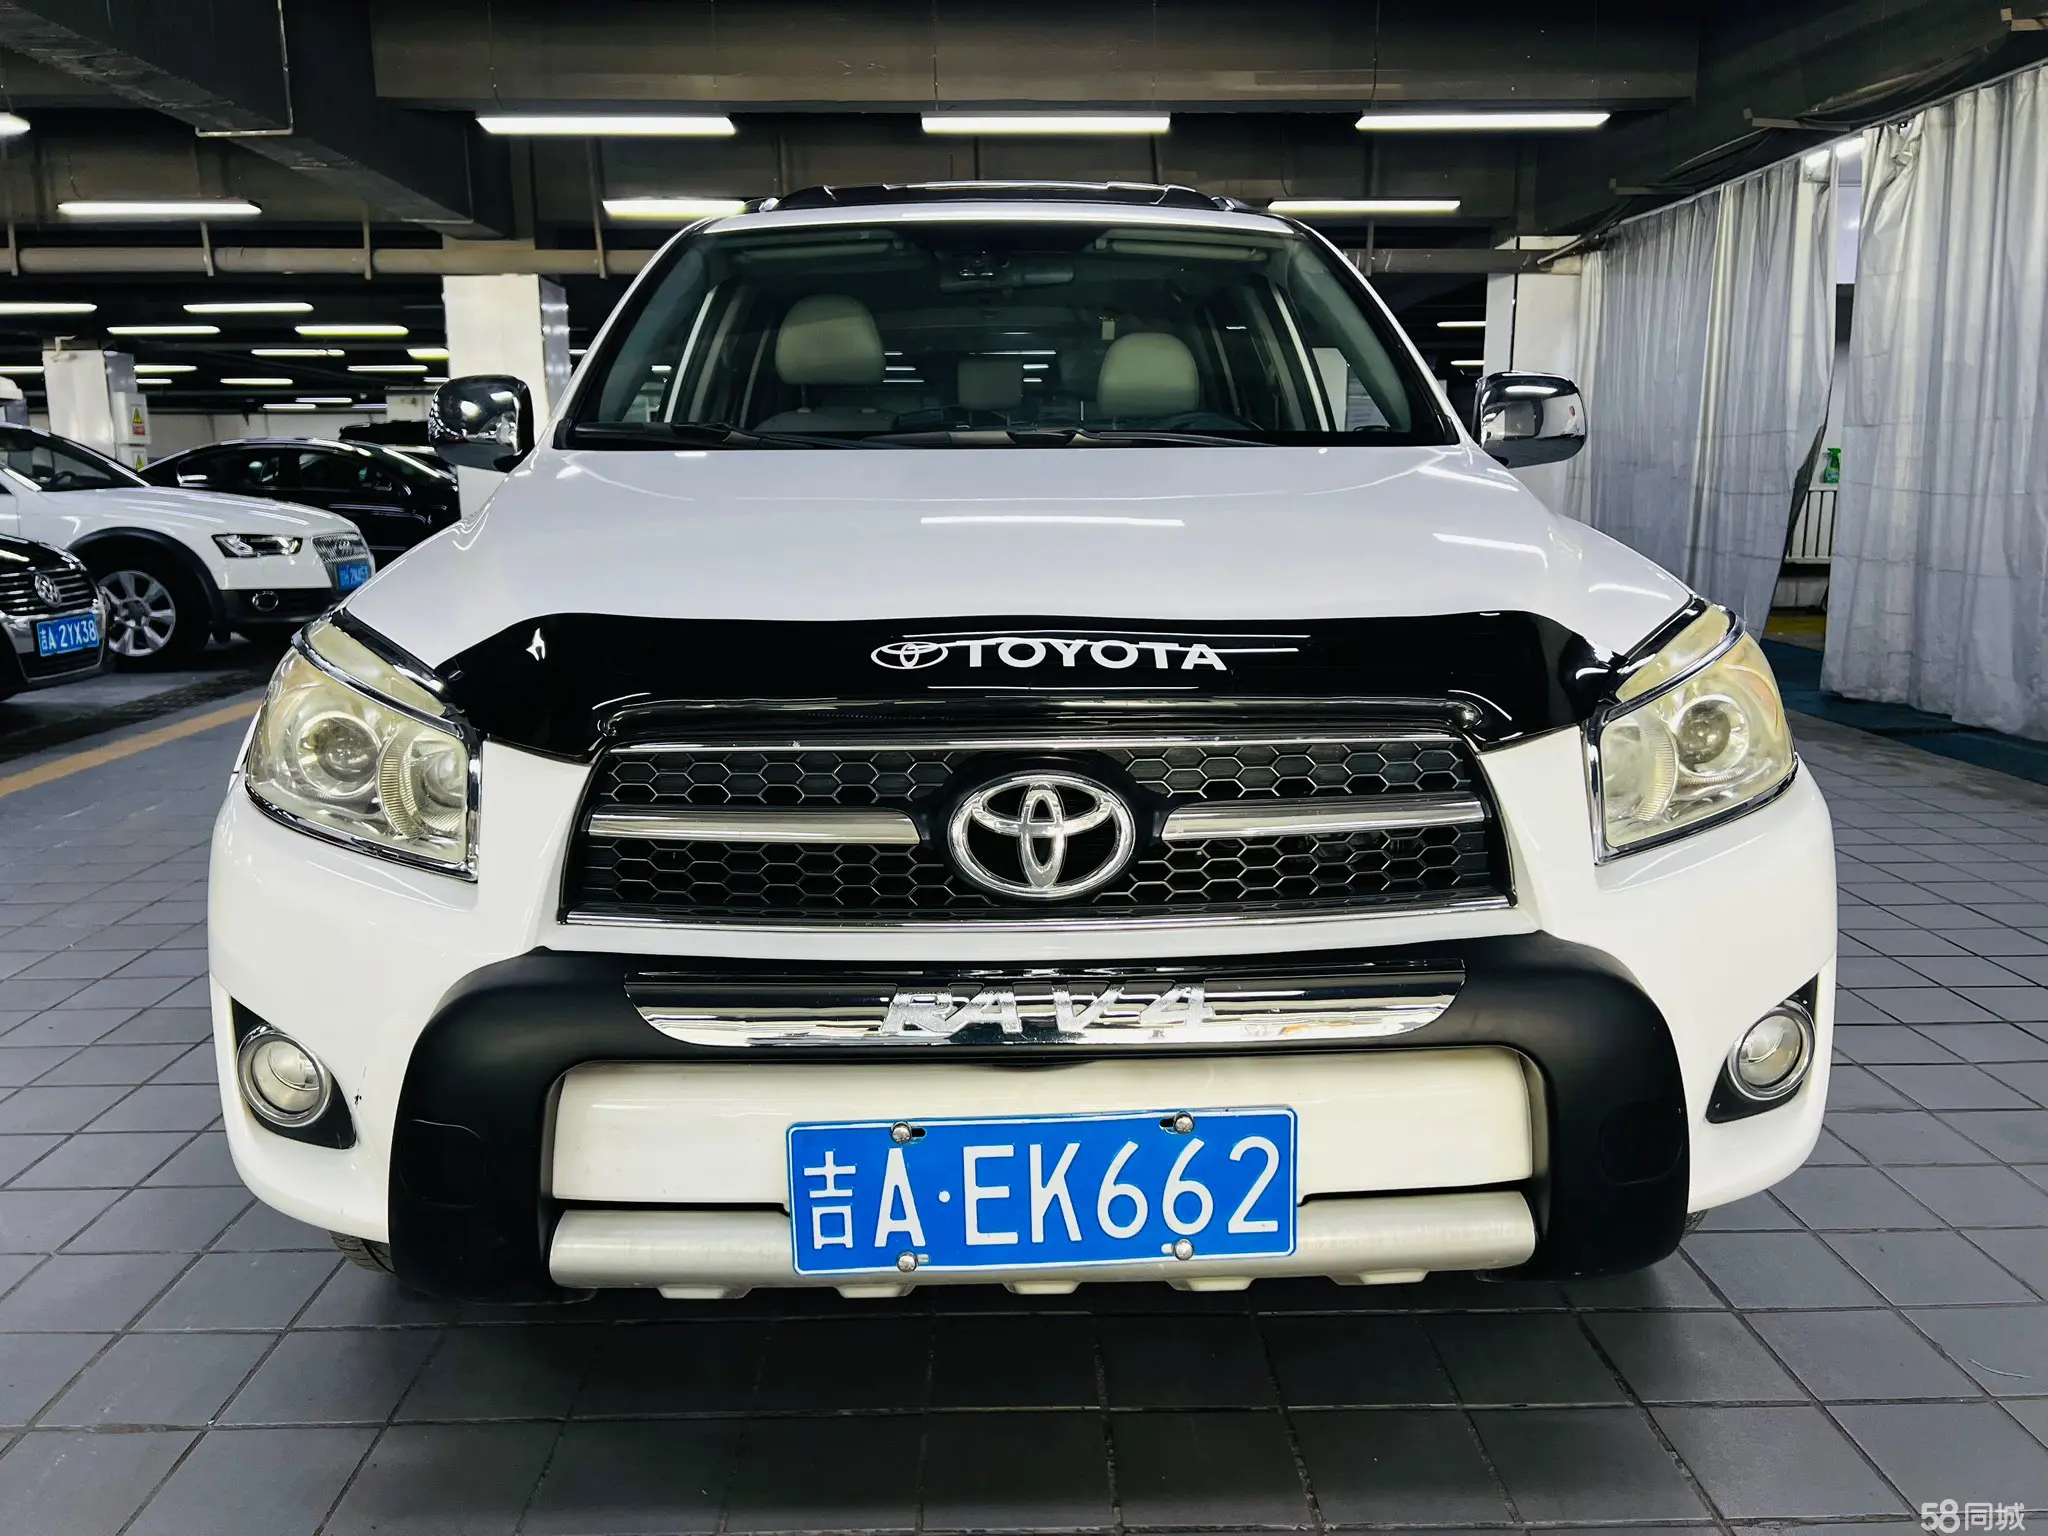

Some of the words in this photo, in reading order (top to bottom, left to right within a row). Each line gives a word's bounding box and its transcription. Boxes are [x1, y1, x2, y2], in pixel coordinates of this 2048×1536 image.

[955, 638, 1228, 671] TOYOTA
[880, 982, 1215, 1034] RAV4
[803, 1135, 1280, 1250] 吉A·EK662
